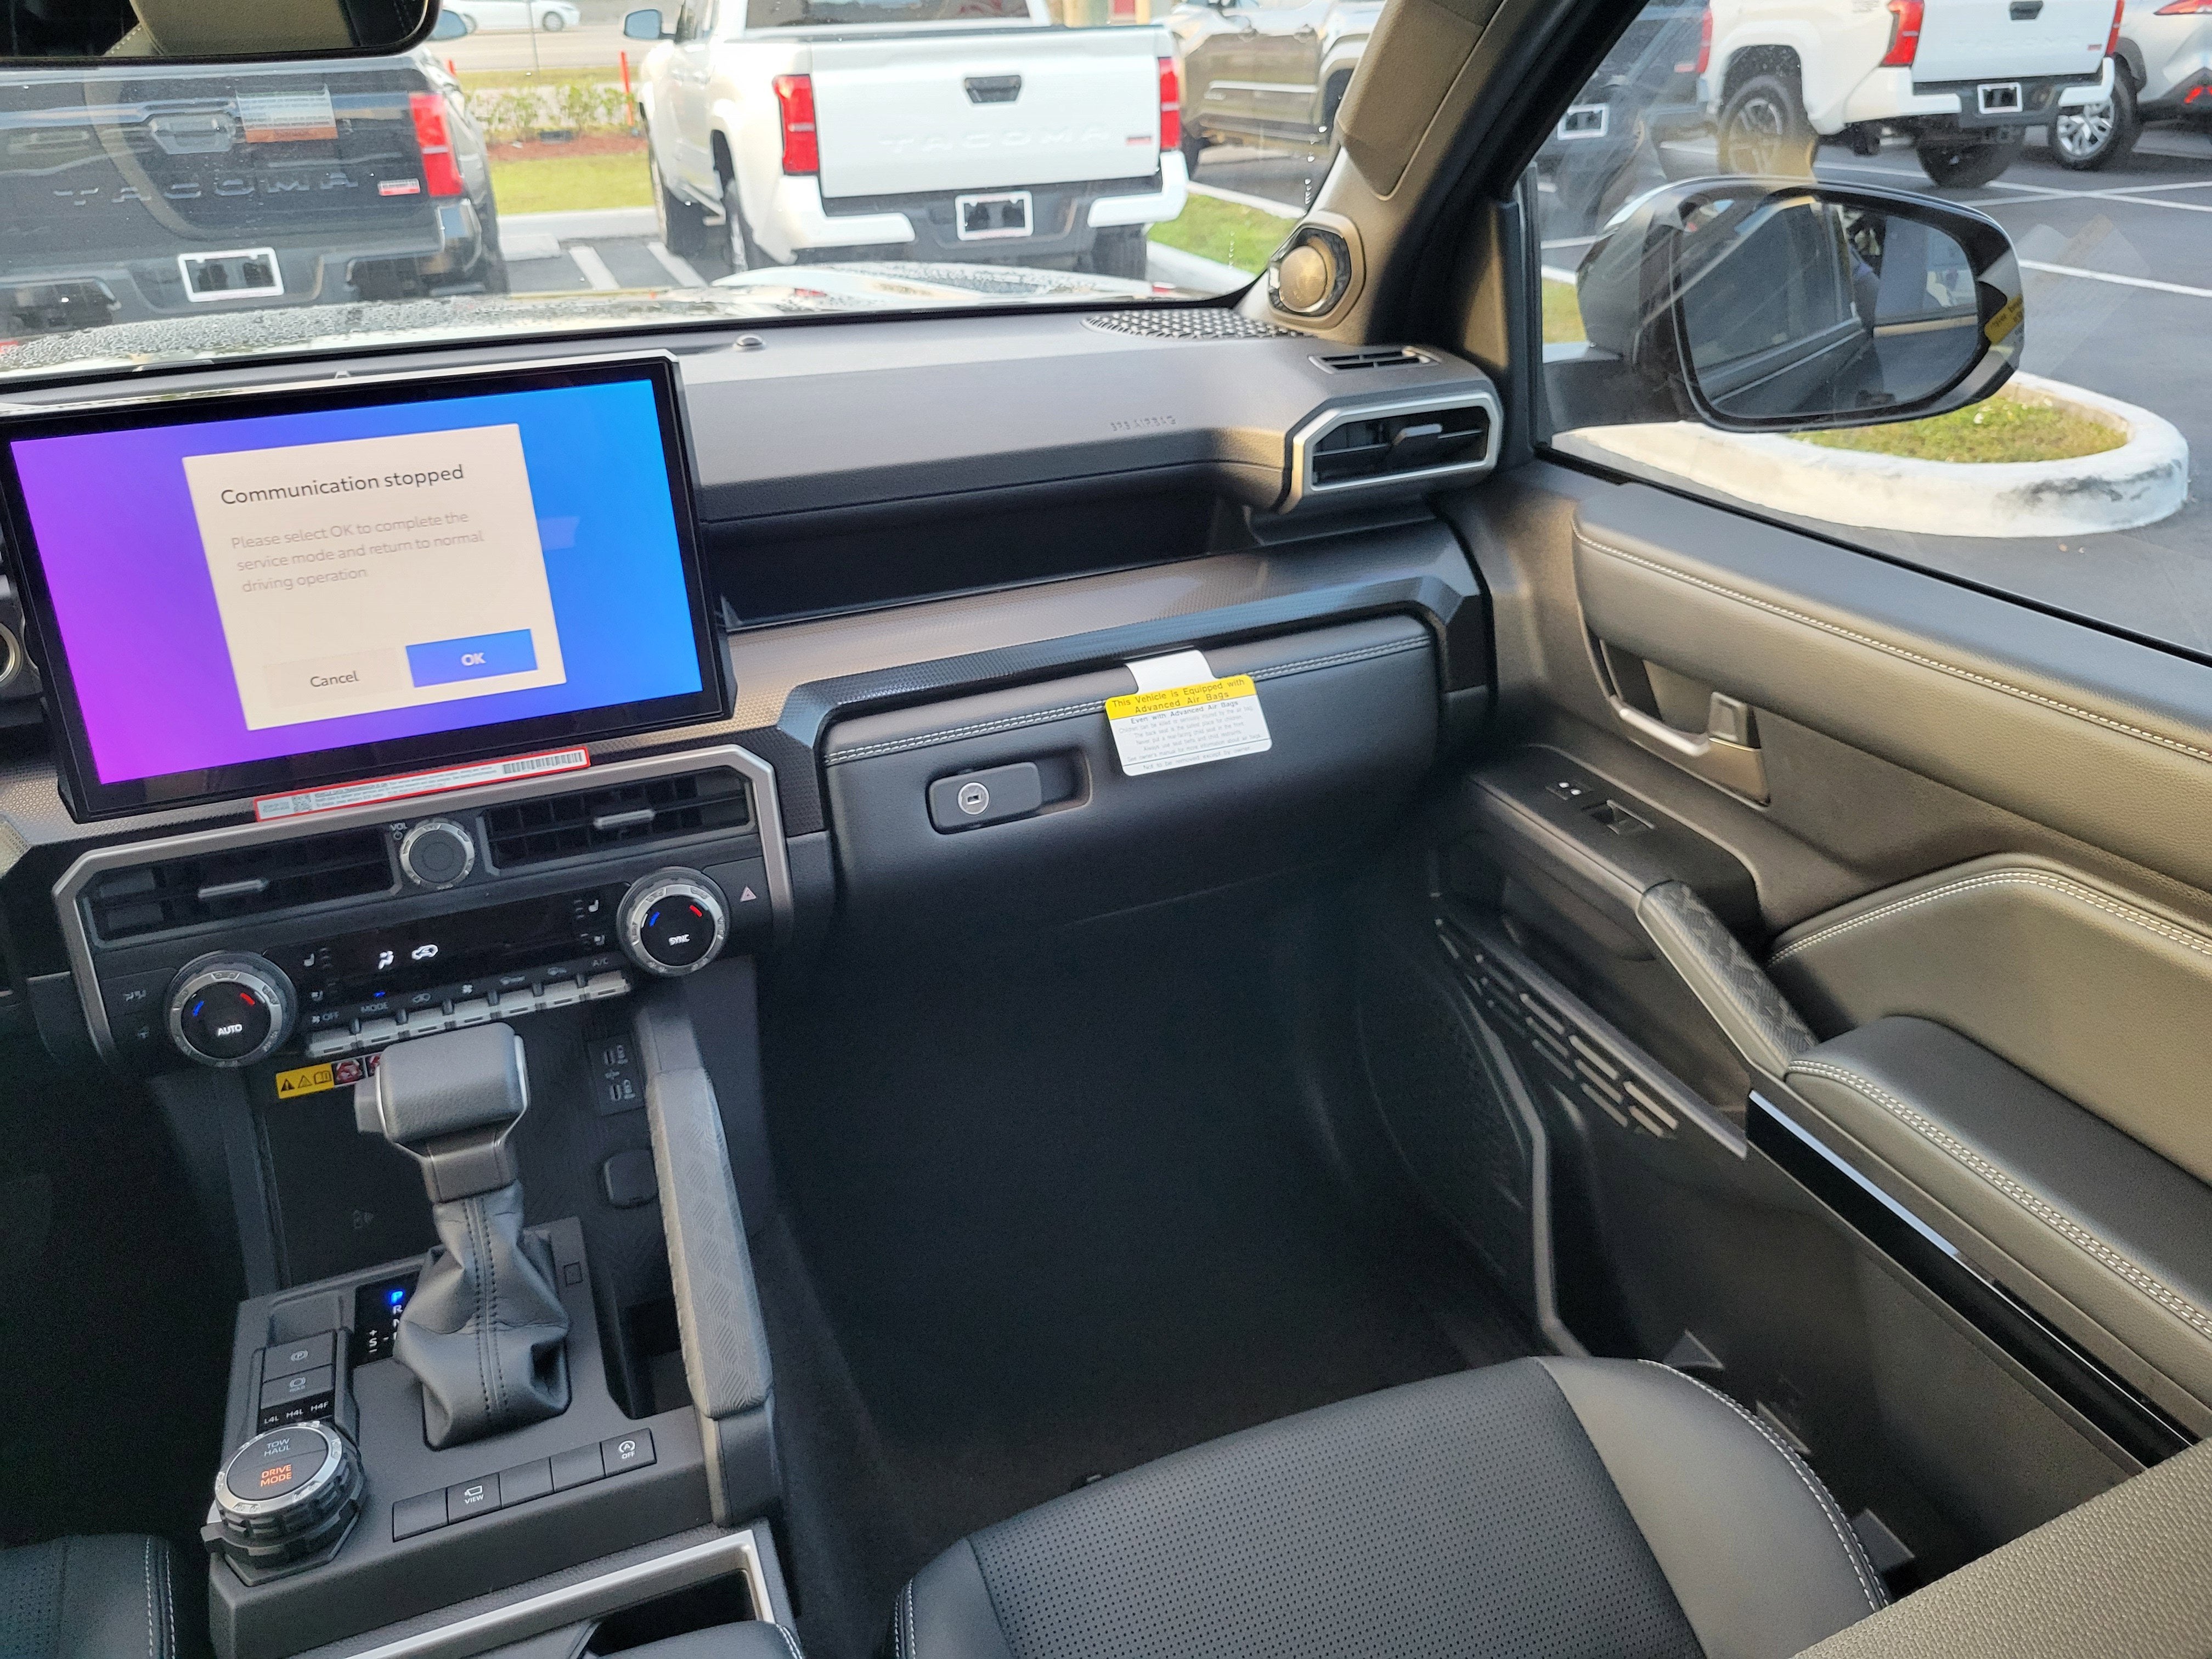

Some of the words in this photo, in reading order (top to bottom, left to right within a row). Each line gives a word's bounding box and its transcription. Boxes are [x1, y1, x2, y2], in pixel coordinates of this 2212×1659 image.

[878, 123, 1109, 154] TACOMA
[54, 172, 359, 206] TACOMA
[221, 475, 380, 504] Communication
[384, 464, 464, 488] stopped
[232, 533, 281, 549] Please
[284, 529, 329, 544] select
[330, 524, 354, 538] OK
[357, 522, 372, 535] to
[375, 515, 442, 533] complete
[444, 510, 469, 524] the
[237, 555, 289, 572] service
[292, 550, 335, 564] mode
[338, 544, 366, 558] and
[369, 541, 413, 555] return
[415, 538, 430, 550] to
[434, 531, 484, 547] normal
[242, 576, 294, 593] driving
[297, 567, 368, 587] operation
[461, 652, 486, 667] OK
[310, 670, 359, 688] Cancel
[1112, 699, 1131, 708] This
[1135, 693, 1167, 704] Vehicle
[1183, 682, 1223, 696] Equipped
[1227, 679, 1245, 687] with
[1135, 699, 1181, 713] Advanced
[1187, 696, 1199, 704] Air
[1206, 692, 1229, 701] Bags
[1170, 707, 1204, 716] Advanced
[390, 822, 408, 831] VOL
[669, 934, 690, 946] SYNC
[592, 958, 608, 967] A/C
[361, 1002, 388, 1013] MODE
[322, 1012, 340, 1021] OFF
[218, 1024, 242, 1035] AUTO
[391, 1291, 403, 1304] P
[393, 1305, 403, 1315] R
[369, 1338, 377, 1347] S
[264, 1415, 279, 1424] L4L
[286, 1409, 303, 1419] H4L
[311, 1401, 329, 1412] H4F
[267, 1437, 290, 1449] TOW
[264, 1444, 291, 1457] HAUL
[622, 1451, 635, 1459] OFF
[261, 1464, 292, 1479] DRIVE
[260, 1471, 292, 1487] MODE
[465, 1494, 484, 1504] VIEW
